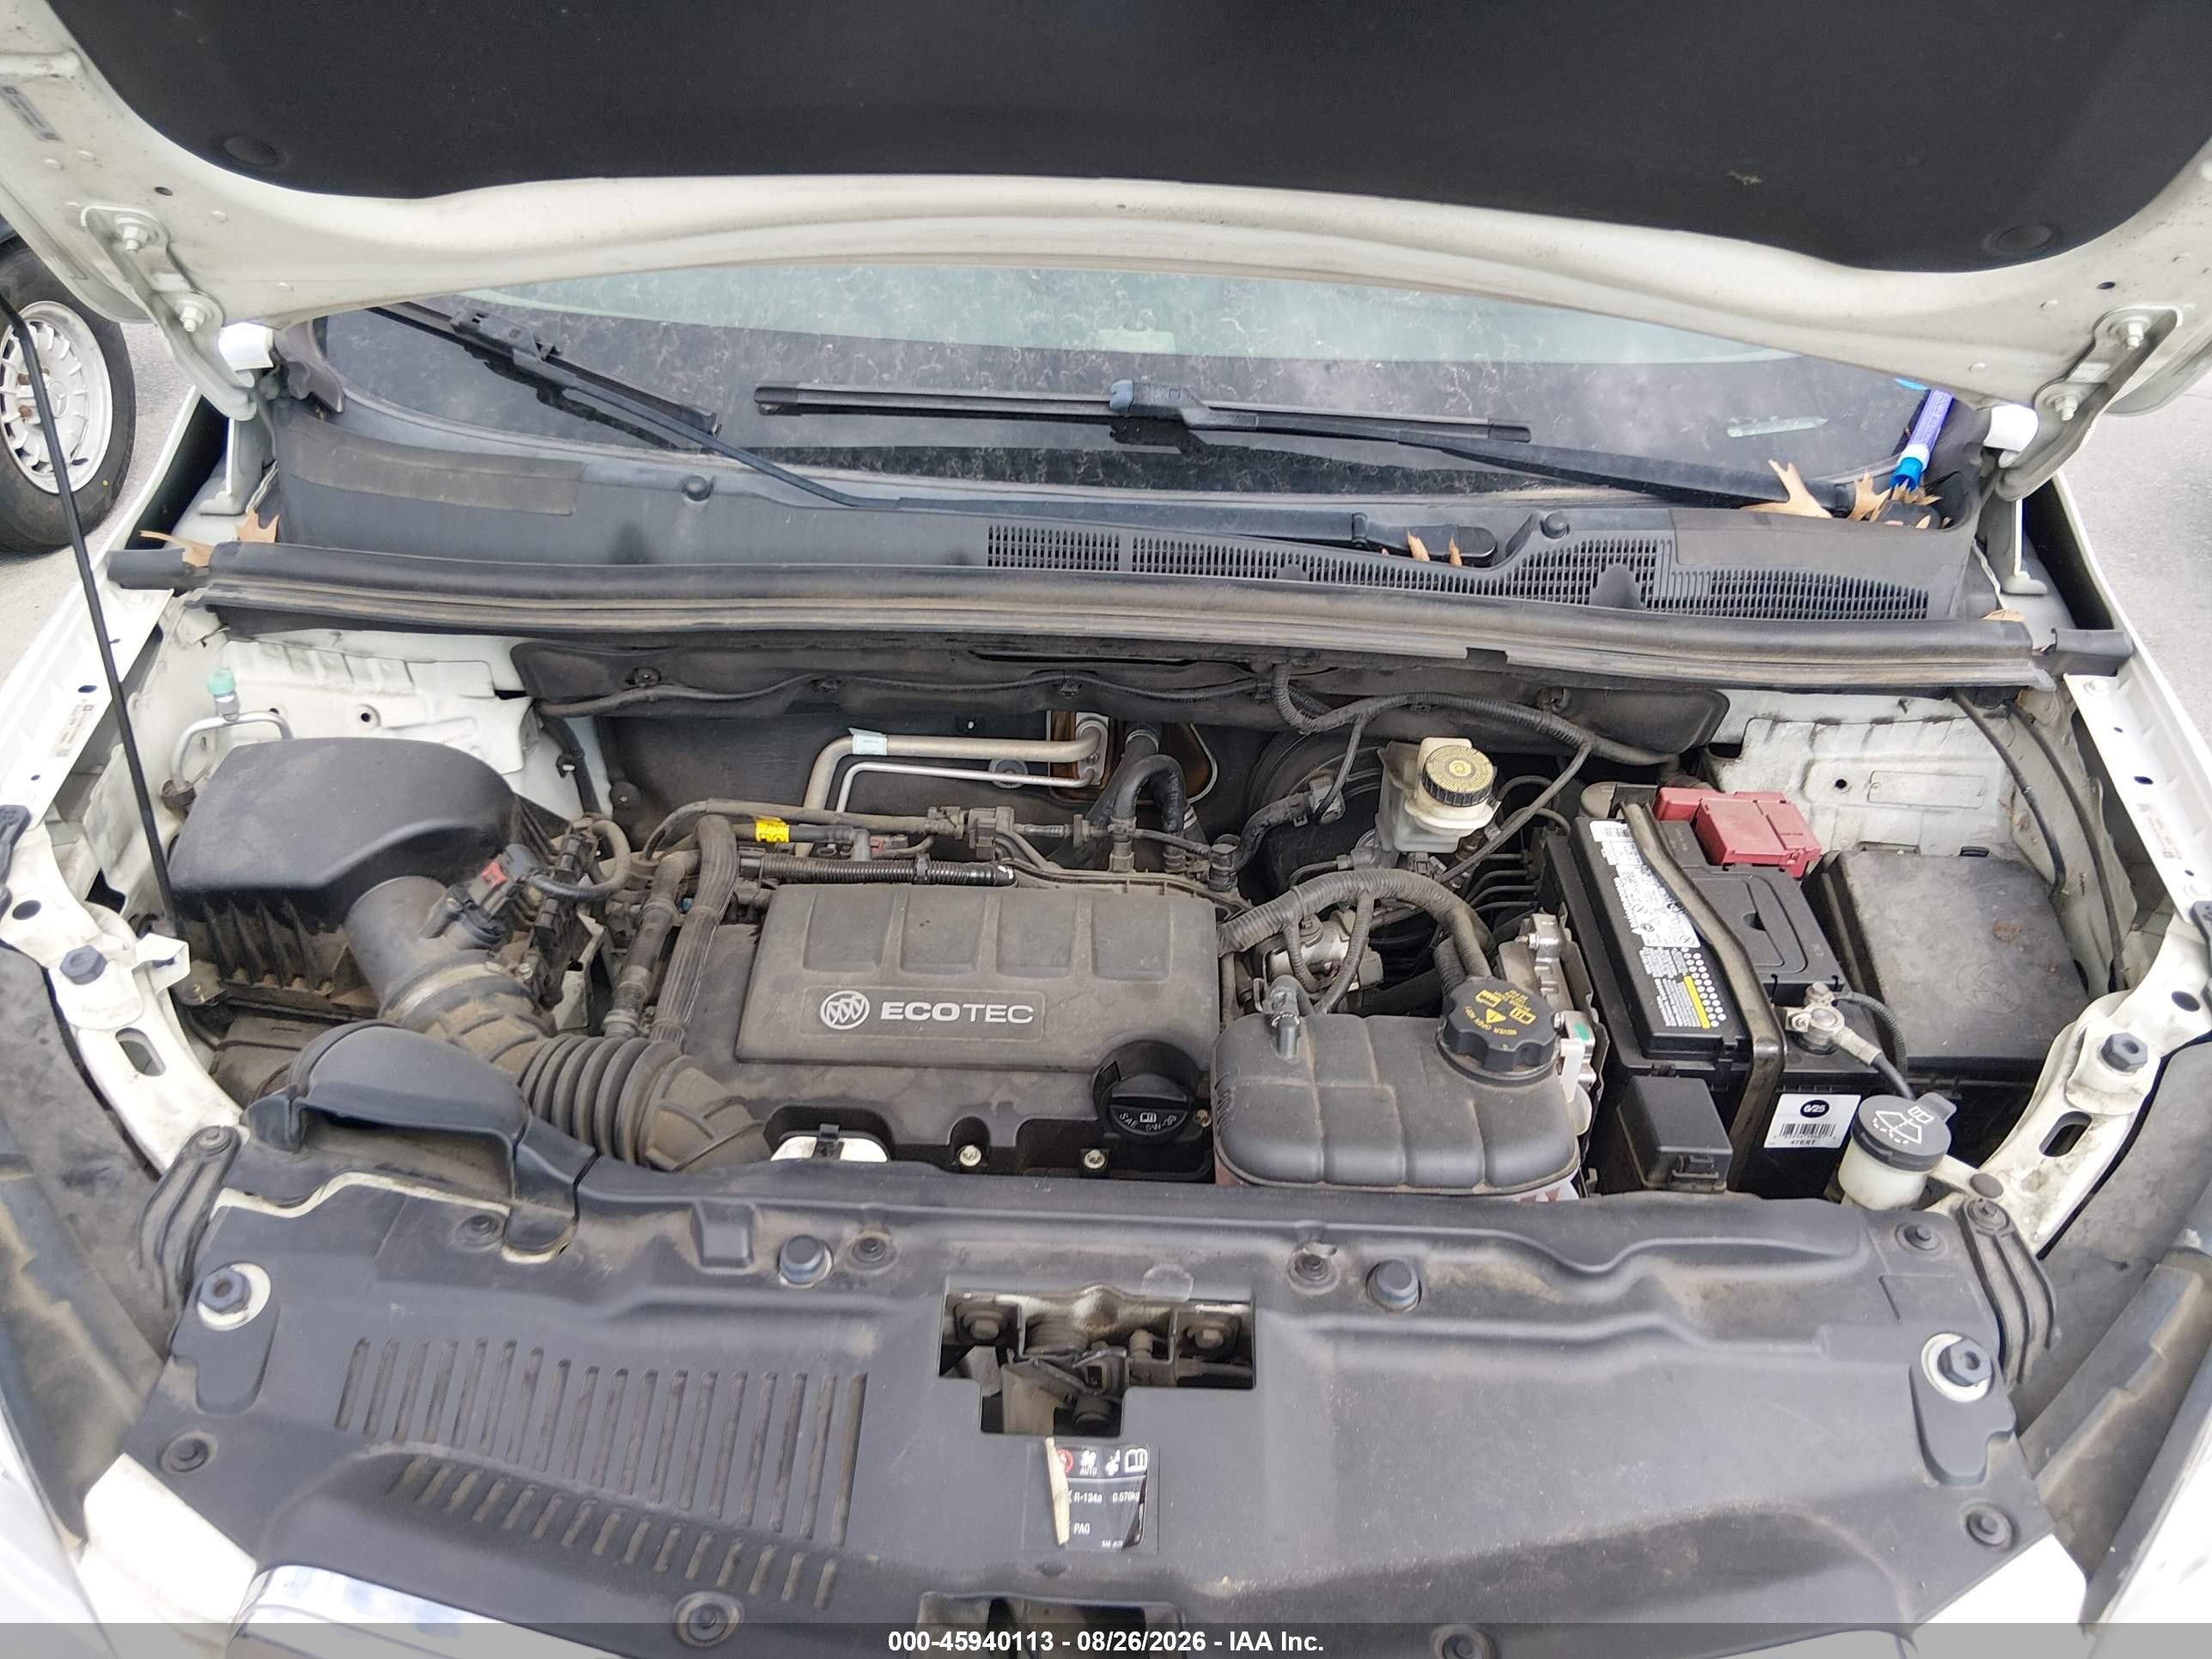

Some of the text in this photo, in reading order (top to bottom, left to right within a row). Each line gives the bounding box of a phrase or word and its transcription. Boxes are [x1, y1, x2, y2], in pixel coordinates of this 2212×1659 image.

[880, 1001, 1034, 1024] ECOTEC
[1803, 1104, 1826, 1113] 6/25
[1119, 1113, 1138, 1127] SAE
[1079, 1467, 1097, 1476] AUTO
[1073, 1492, 1103, 1504] R-134a
